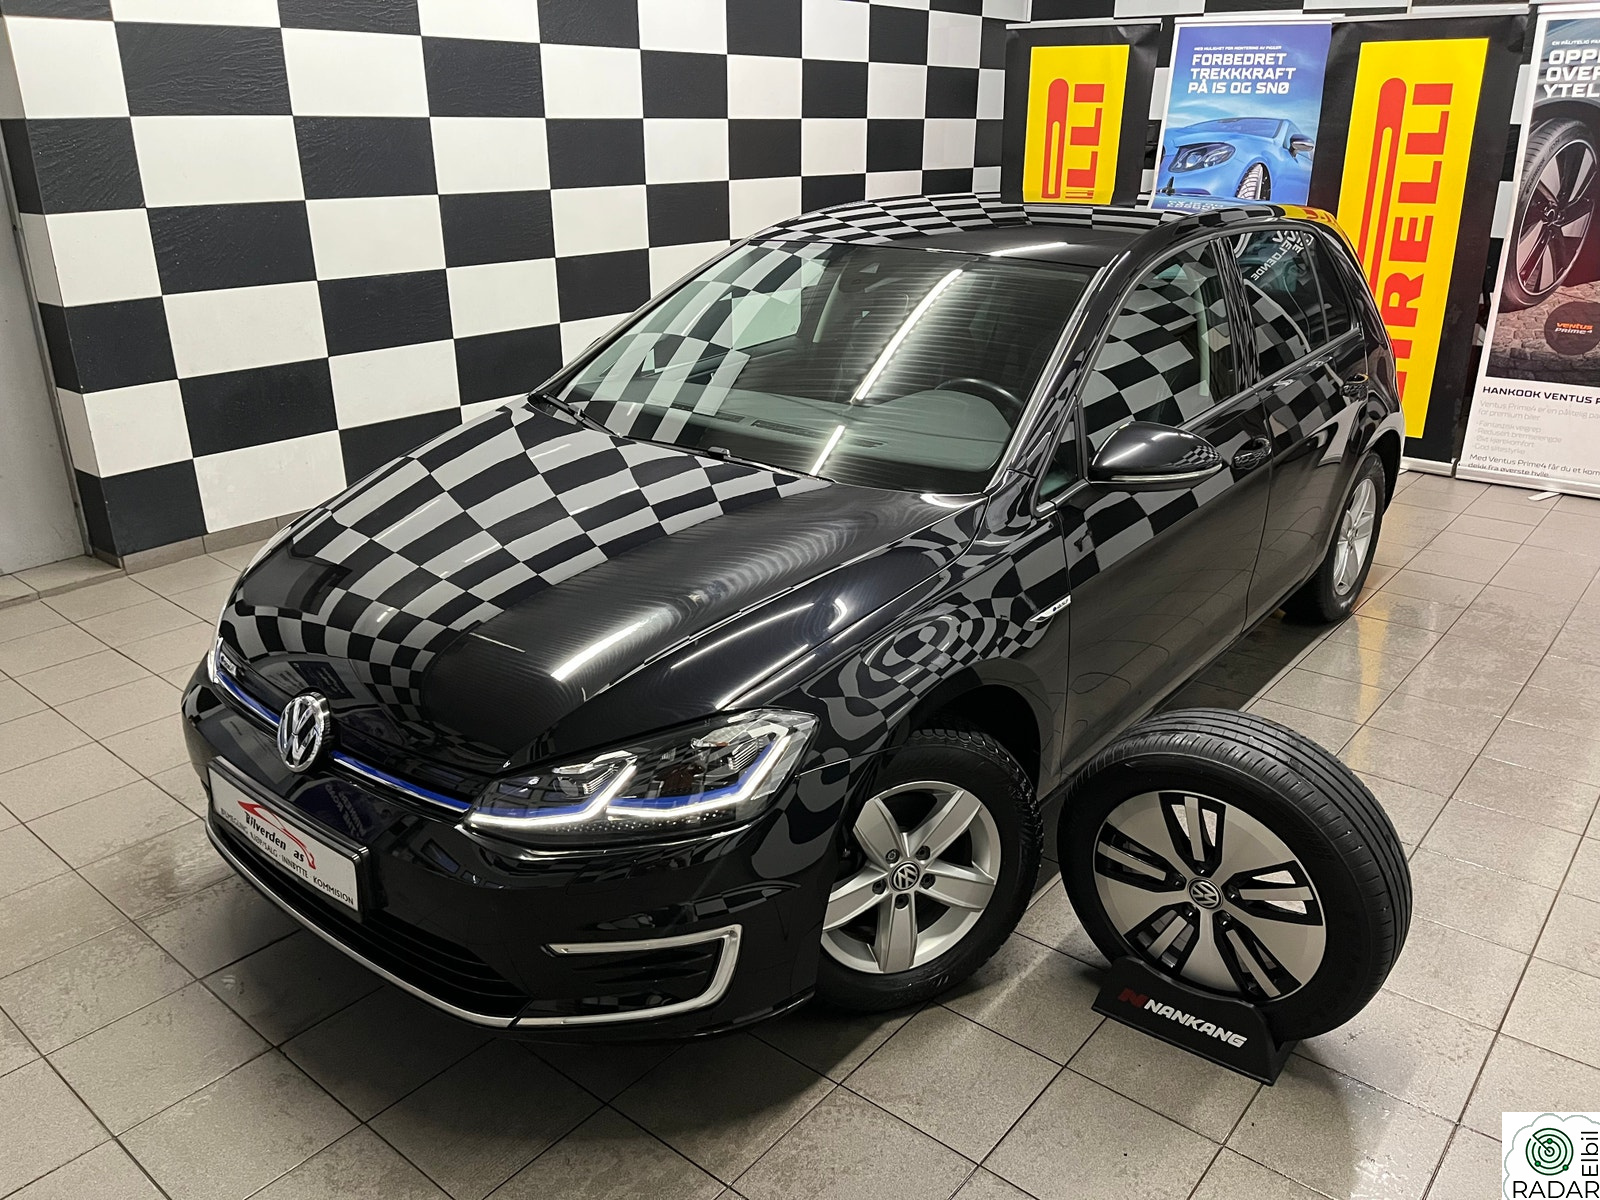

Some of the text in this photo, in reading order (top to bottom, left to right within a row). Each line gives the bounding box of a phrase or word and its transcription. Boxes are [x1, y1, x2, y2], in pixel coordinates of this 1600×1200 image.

[1192, 53, 1287, 66] FORBEDRET
[1549, 49, 1600, 65] OPP
[1190, 67, 1296, 80] TREKKKRAFT
[1188, 79, 1290, 94] PÅ IS OG SNØ
[1482, 386, 1592, 404] HANKOOK VENTUS
[1470, 454, 1488, 462] Med
[1488, 455, 1516, 466] Ventus
[1517, 459, 1547, 469] Prime4
[1548, 462, 1559, 470] får
[1561, 464, 1571, 472] du
[293, 849, 305, 863] as
[313, 875, 354, 905] KOMMISION
[1143, 998, 1248, 1048] NANKANG
